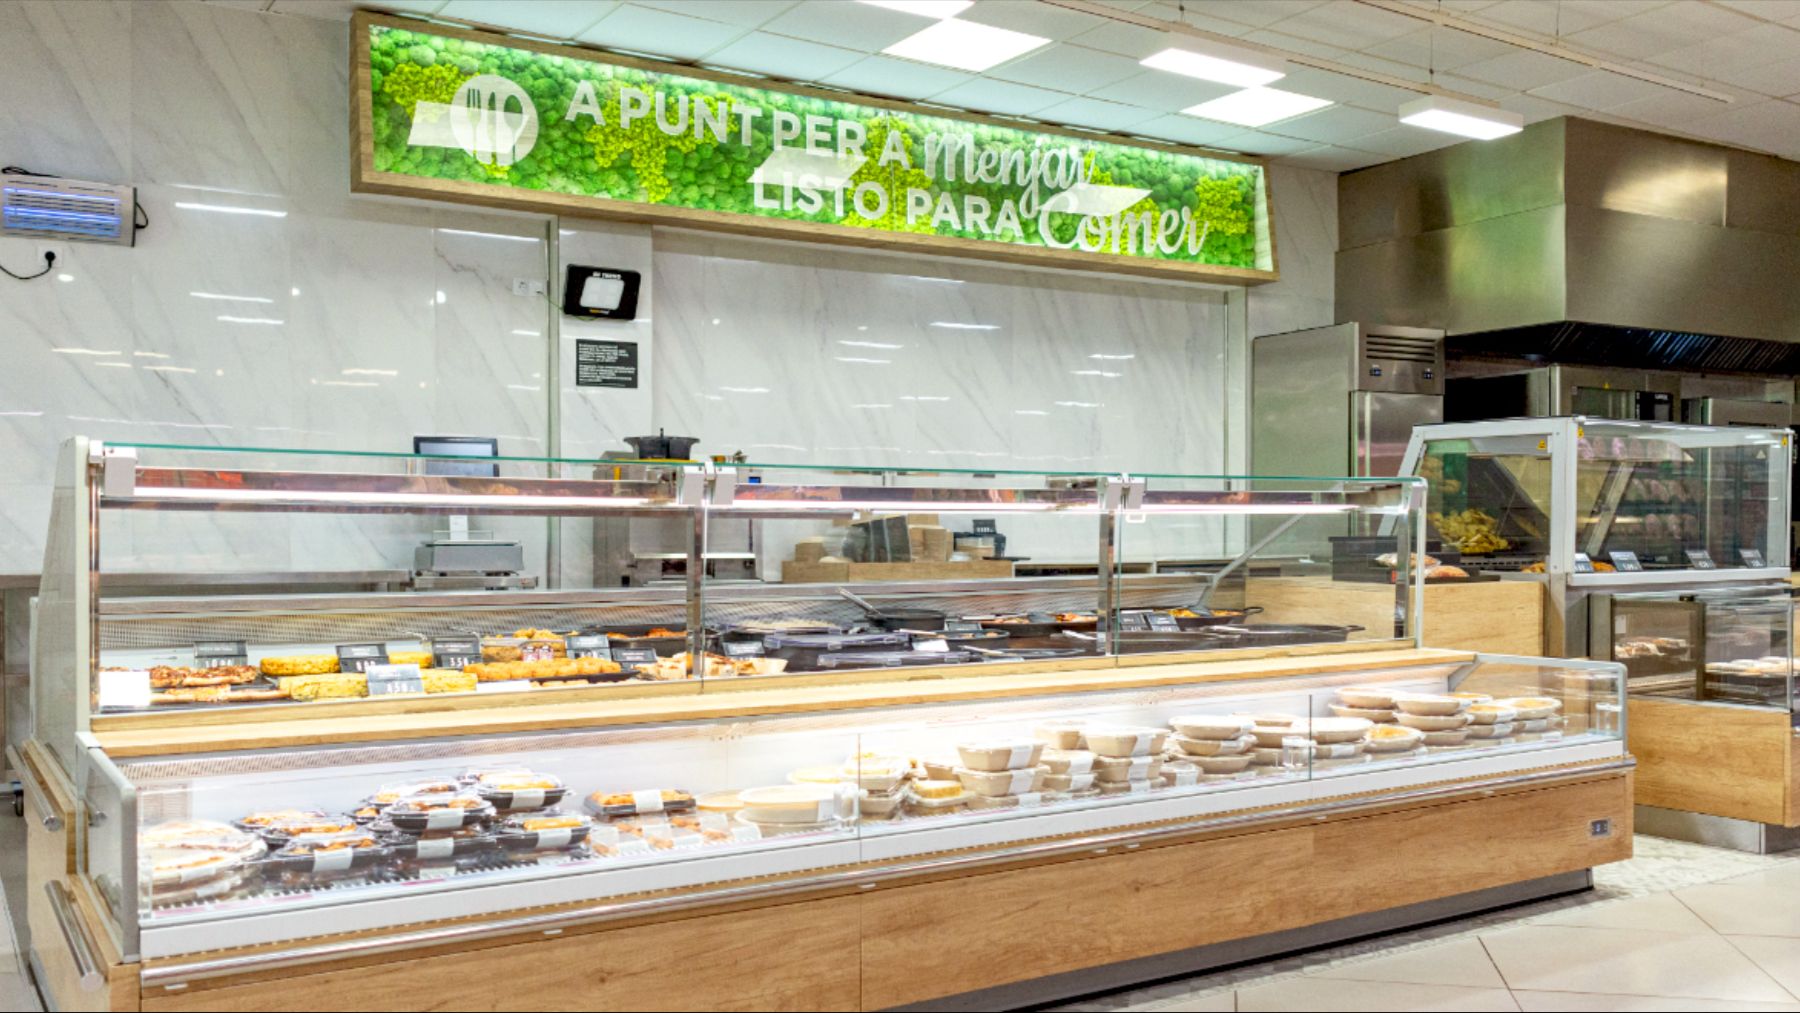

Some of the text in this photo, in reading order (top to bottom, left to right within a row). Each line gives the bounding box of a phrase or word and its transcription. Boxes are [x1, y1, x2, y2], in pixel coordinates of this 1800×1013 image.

[565, 79, 1096, 218] A PUNT PER A Menjar
[754, 168, 1206, 256] LISTO PARA Comer
